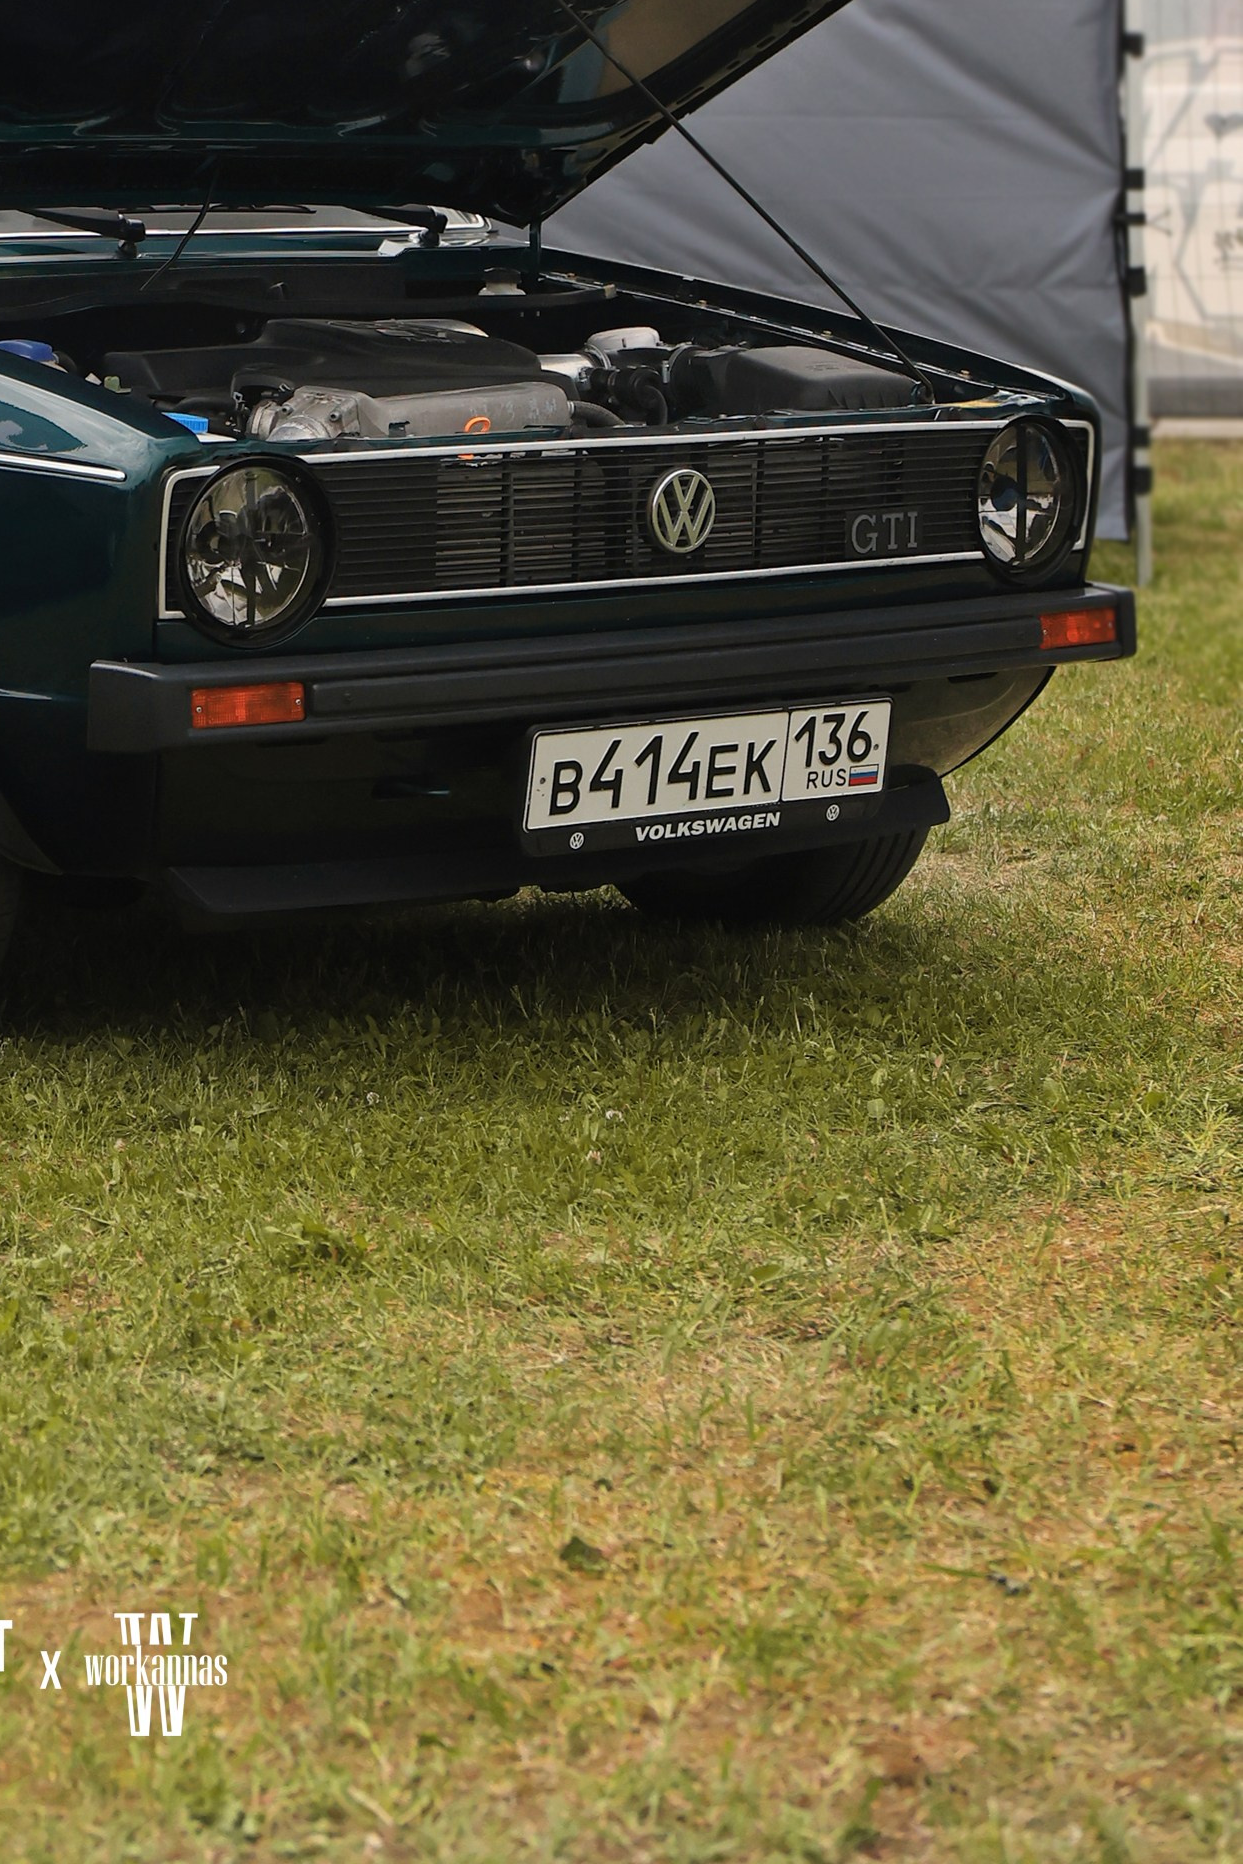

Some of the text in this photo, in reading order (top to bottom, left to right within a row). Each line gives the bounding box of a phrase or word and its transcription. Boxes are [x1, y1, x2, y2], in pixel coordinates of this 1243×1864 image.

[850, 511, 919, 555] GTI
[793, 710, 872, 768] 136
[807, 768, 847, 790] RUS
[634, 811, 781, 842] VOLKSWAGEN
